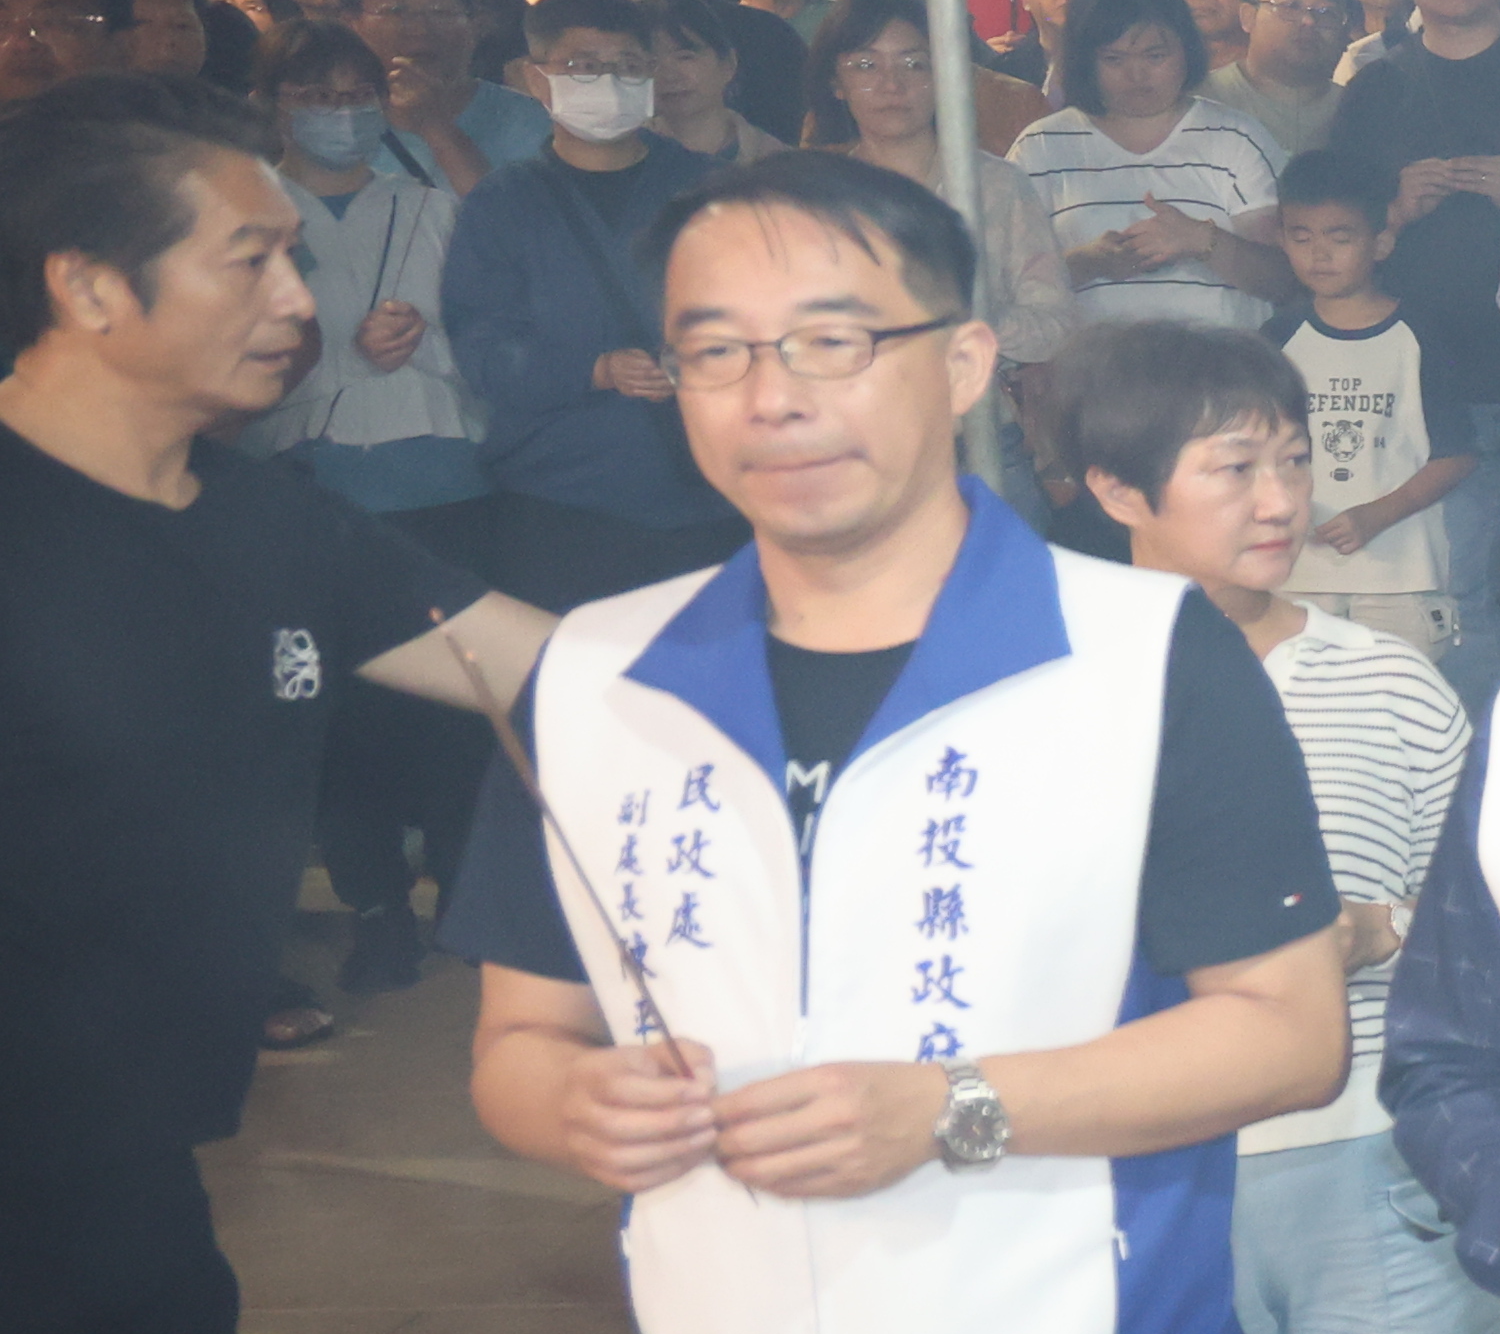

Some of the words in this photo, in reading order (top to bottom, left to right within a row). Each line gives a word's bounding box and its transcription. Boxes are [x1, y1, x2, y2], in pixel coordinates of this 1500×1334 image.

[1307, 393, 1396, 418] EFENDER
[1329, 378, 1362, 392] TOP
[666, 762, 722, 949] 民政處
[911, 746, 978, 1063] 南投縣政府
